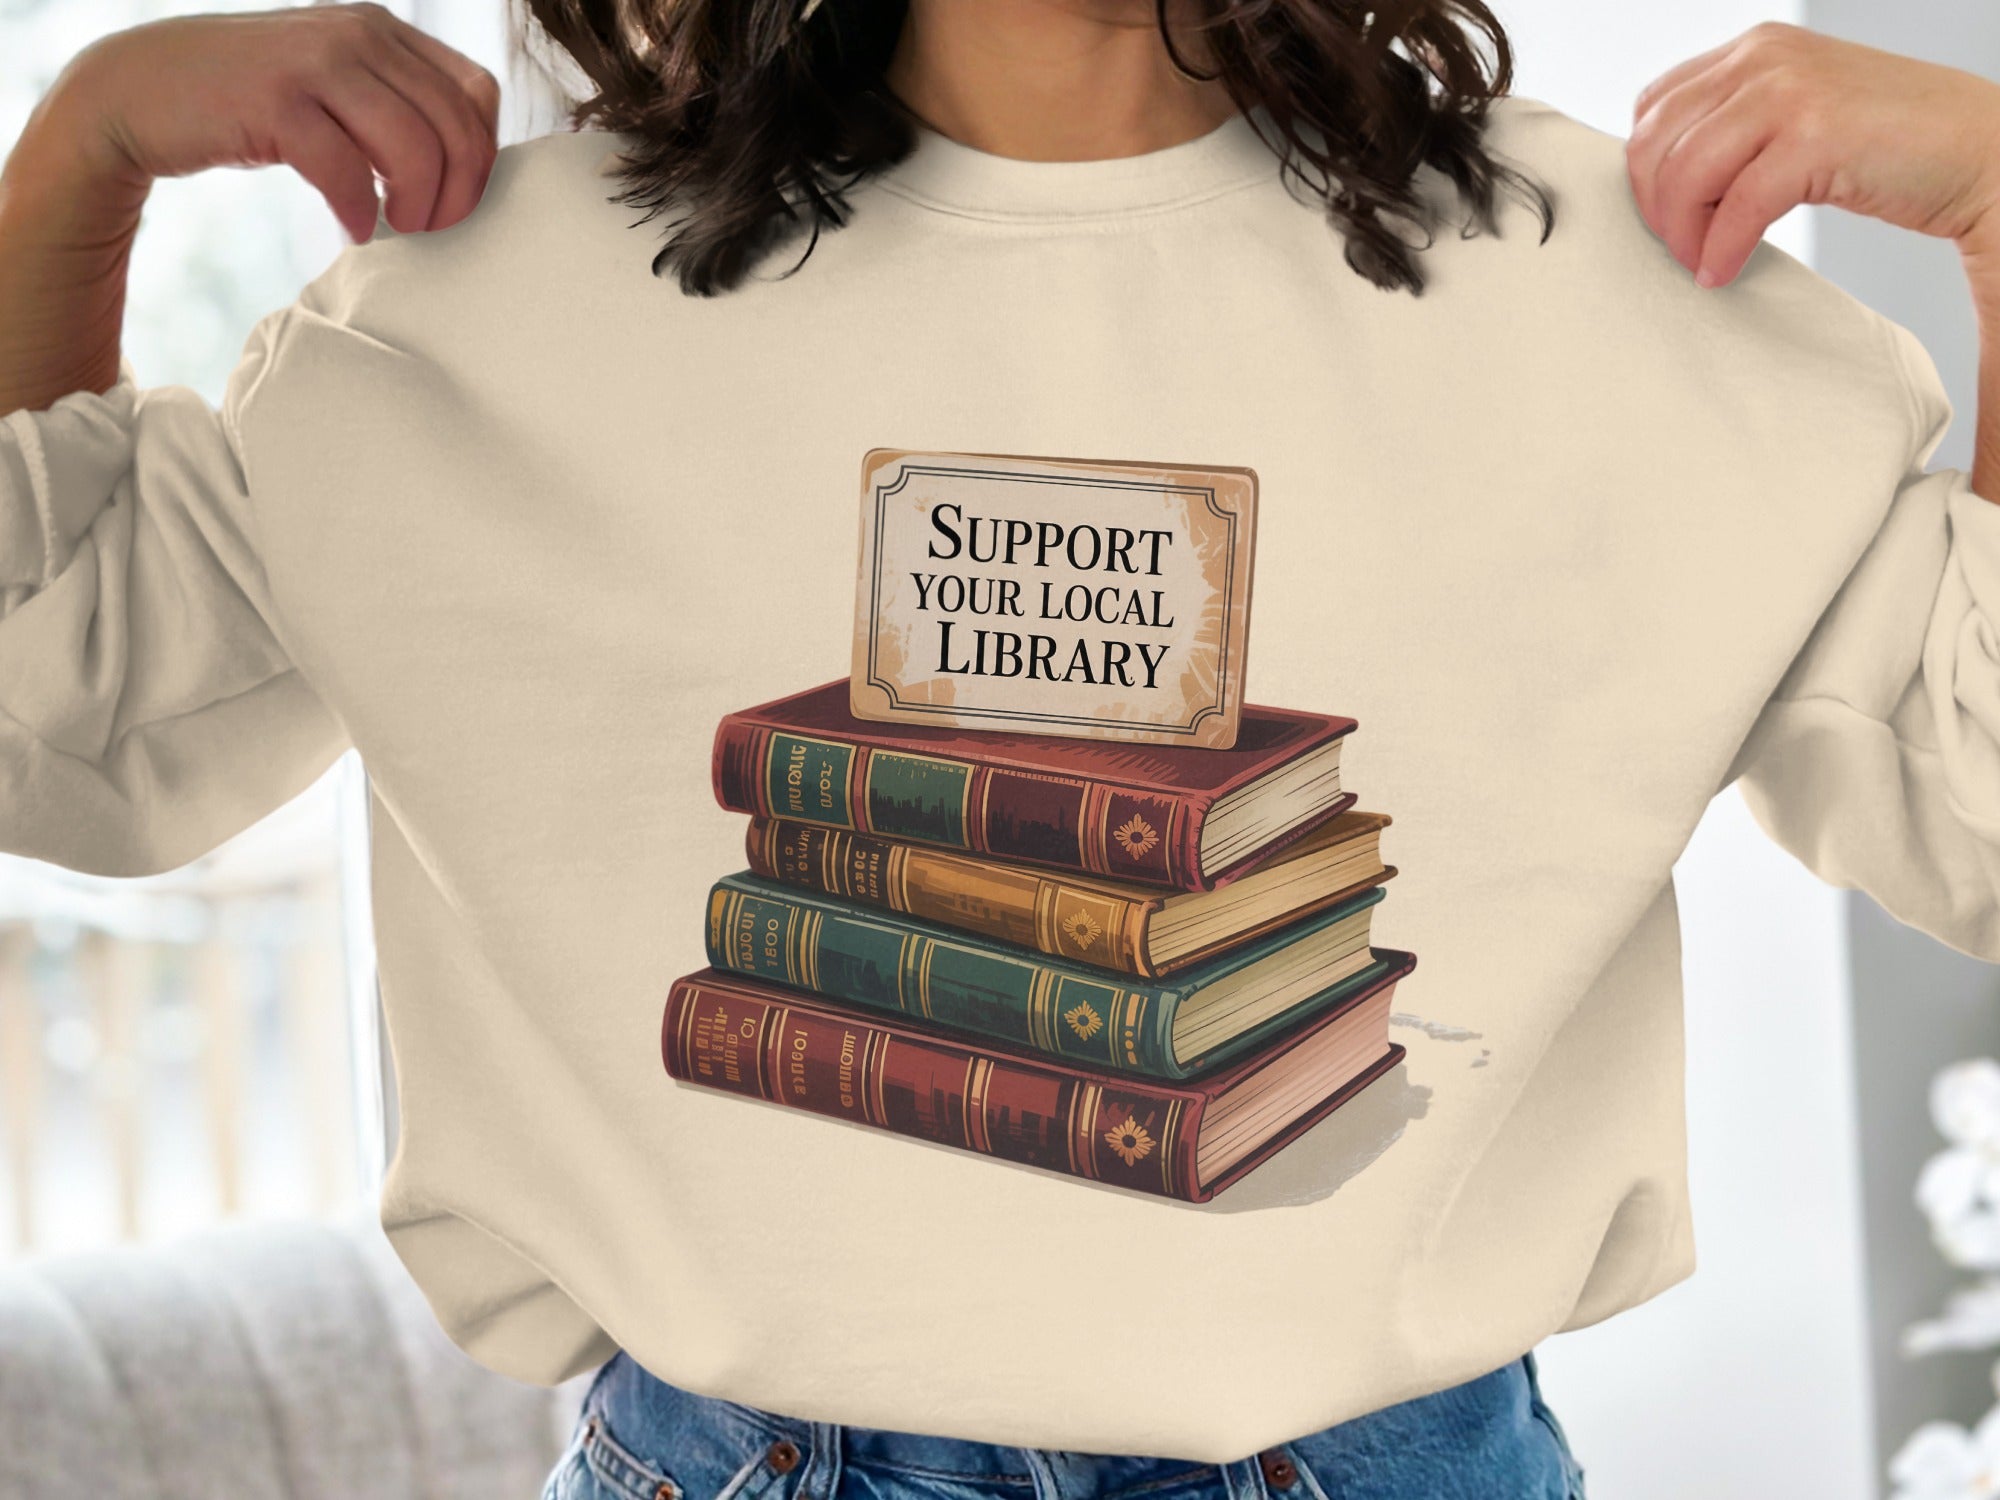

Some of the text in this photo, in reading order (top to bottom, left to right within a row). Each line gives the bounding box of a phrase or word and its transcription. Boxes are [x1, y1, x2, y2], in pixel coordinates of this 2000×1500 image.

[928, 503, 1173, 576] SUPPORT
[910, 572, 1174, 628] YOUR LOCAL
[935, 620, 1171, 689] LIBRARY
